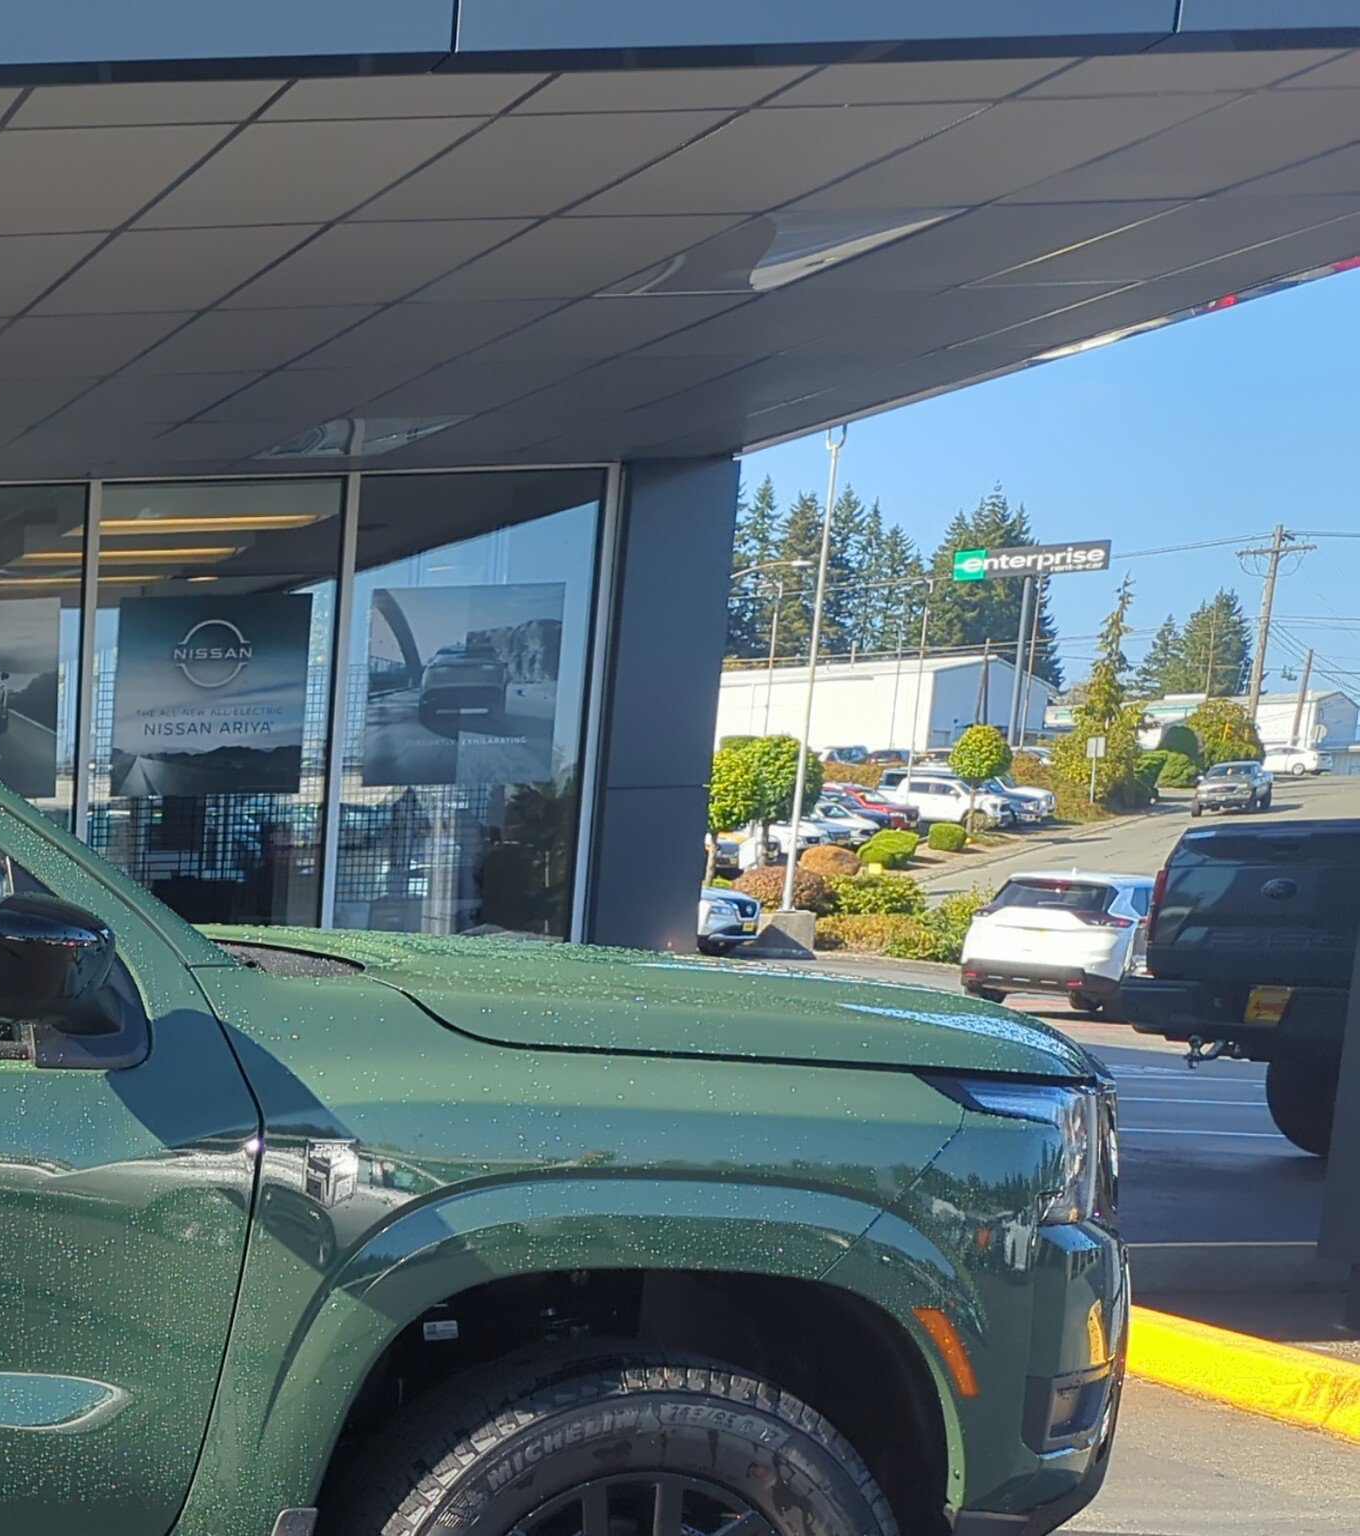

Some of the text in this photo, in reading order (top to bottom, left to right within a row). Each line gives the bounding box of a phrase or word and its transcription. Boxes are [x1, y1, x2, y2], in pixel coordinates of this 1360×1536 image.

[962, 547, 1105, 573] enterprise
[1049, 562, 1104, 573] rent-a-car
[173, 648, 252, 659] NISSAN
[136, 709, 154, 718] THE
[211, 706, 283, 716] ALL-ELECTRIC
[144, 722, 212, 736] NISSAN
[487, 1411, 633, 1488] MICHELIN
